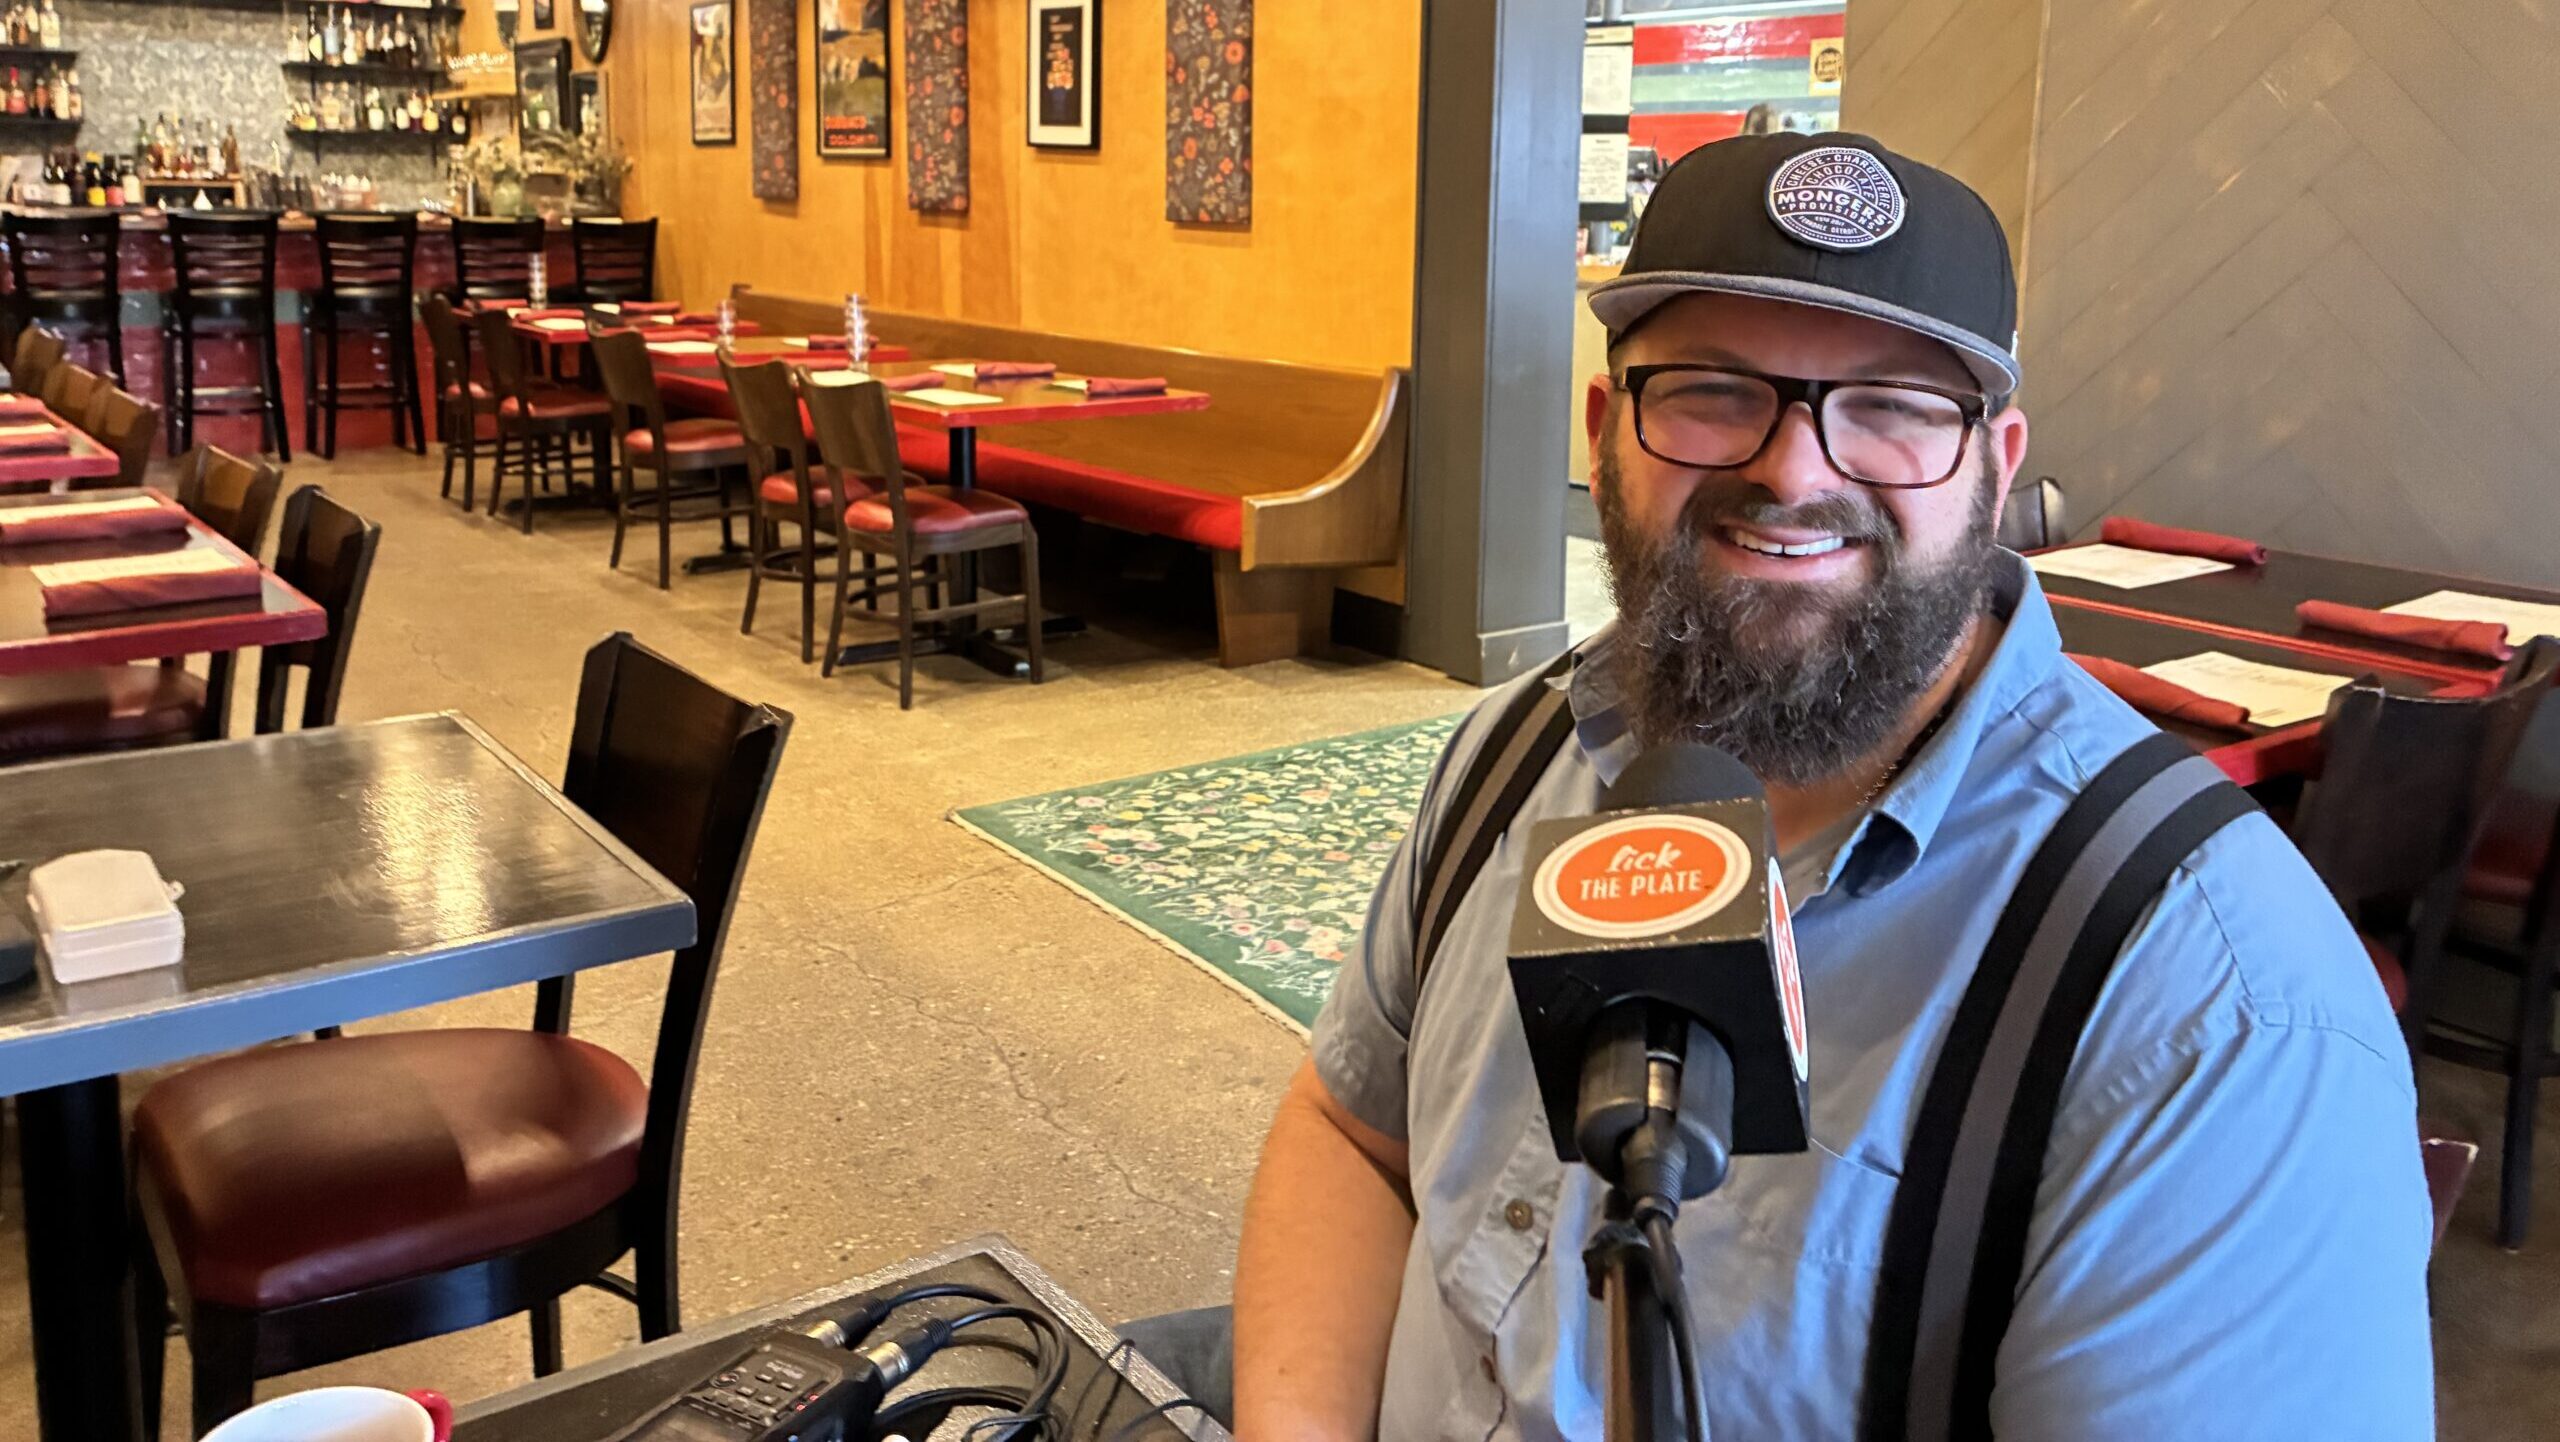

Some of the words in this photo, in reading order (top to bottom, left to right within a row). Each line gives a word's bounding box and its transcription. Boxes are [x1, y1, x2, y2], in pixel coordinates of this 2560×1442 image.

[1786, 157, 1825, 186] CHEESE
[1834, 154, 1890, 210] CHARCUTERIE
[1806, 165, 1875, 200] CHOCOLATE
[1789, 202, 1875, 230] PROVISIONS
[1580, 876, 1621, 900] THE
[1630, 869, 1702, 897] PLATE
